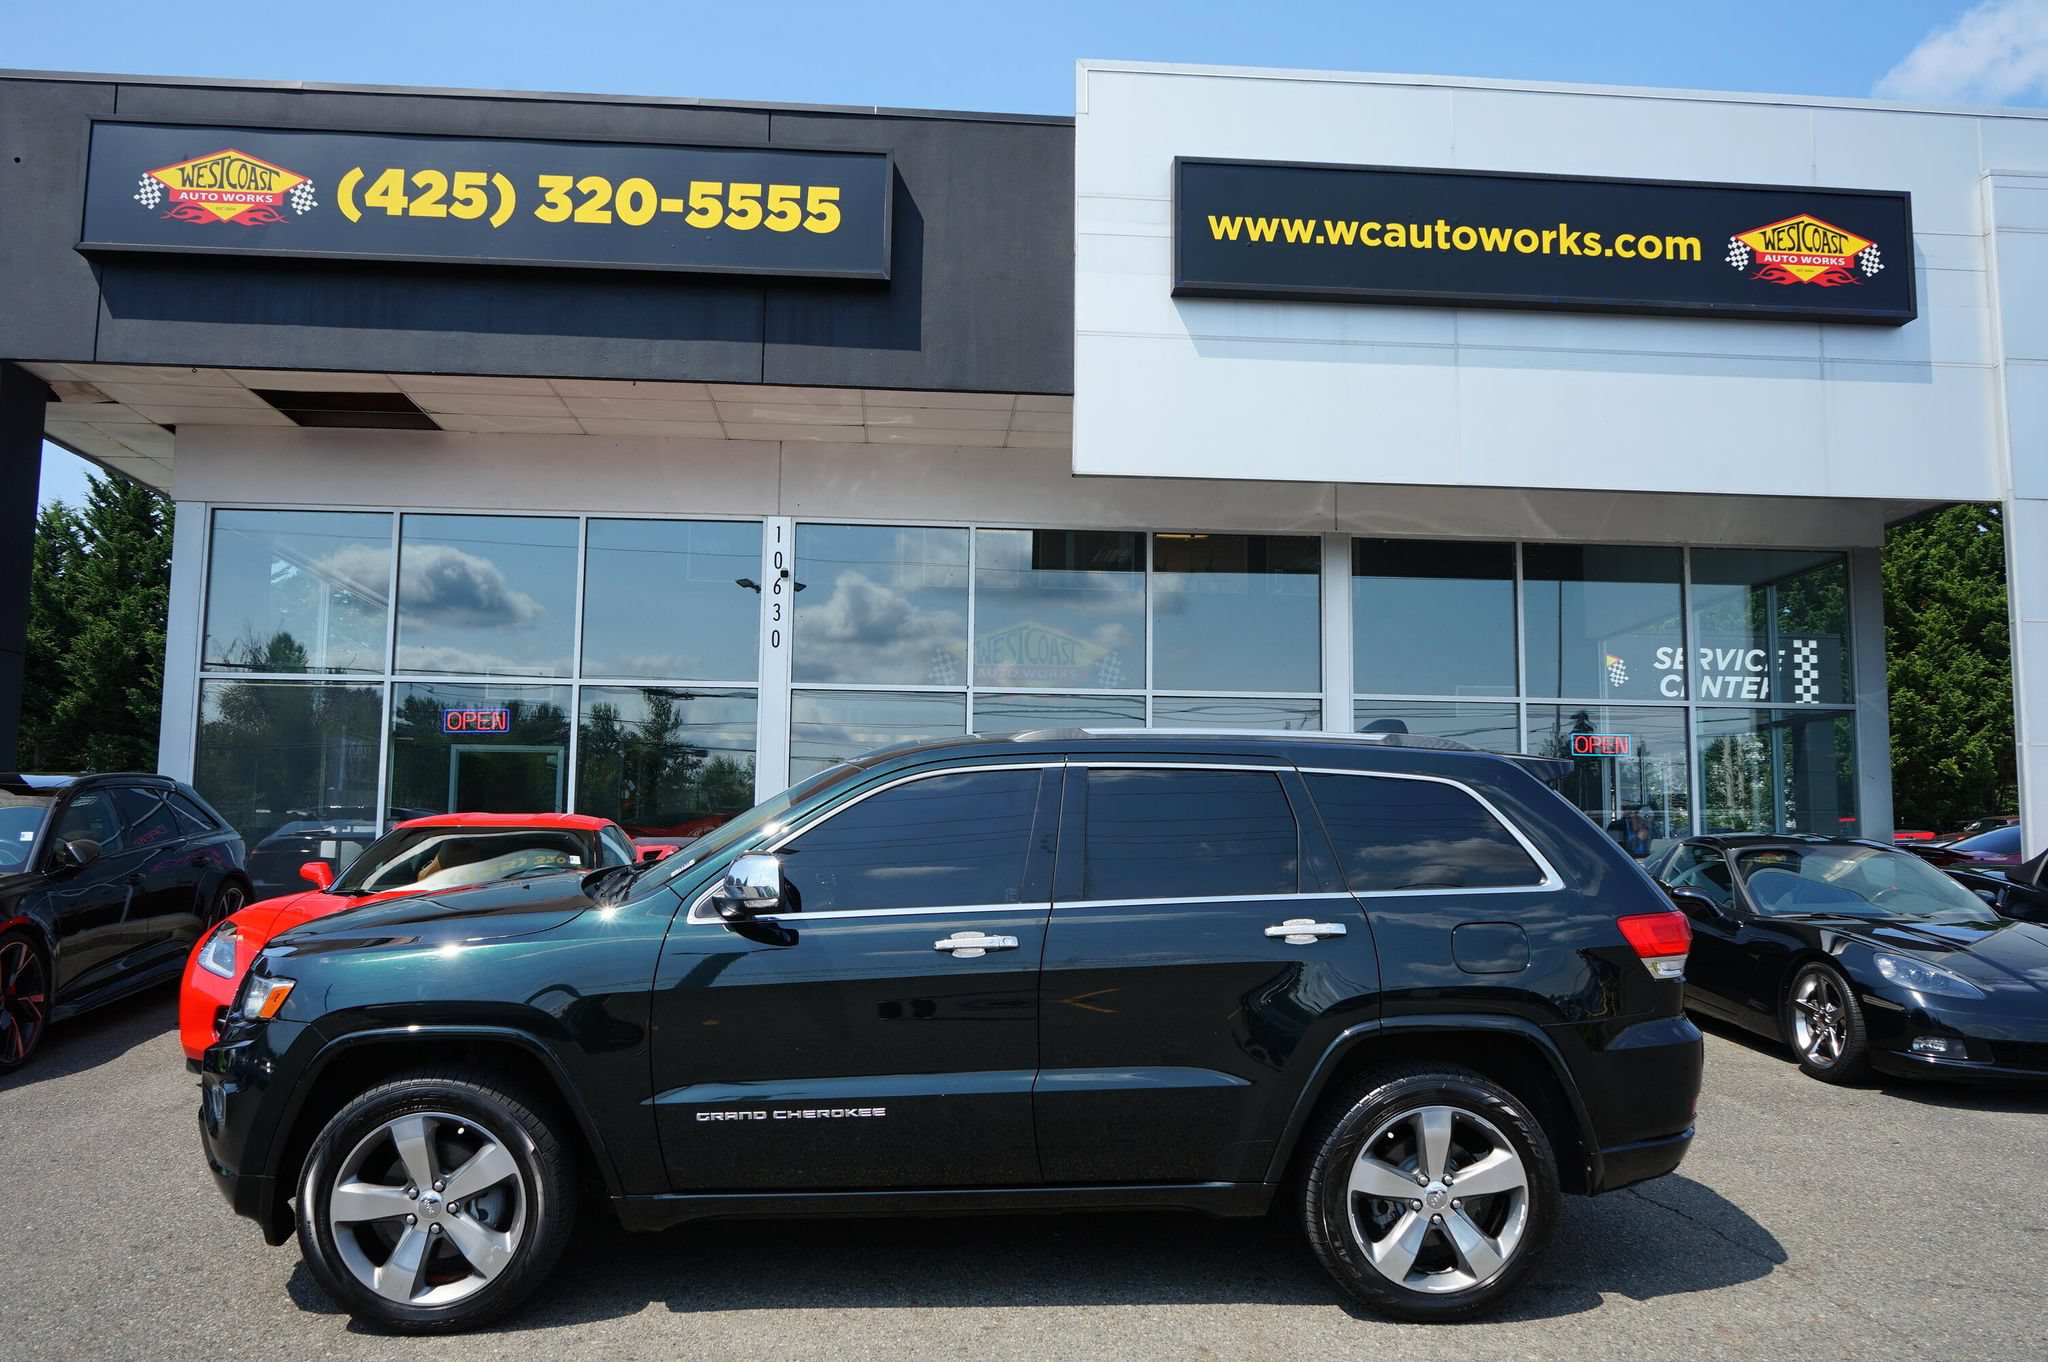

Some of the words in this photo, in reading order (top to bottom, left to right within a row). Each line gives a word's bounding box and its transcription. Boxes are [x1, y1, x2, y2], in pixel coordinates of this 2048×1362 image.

[179, 191, 218, 201] AUTO
[222, 193, 273, 203] WORKS
[337, 167, 516, 228] (425)
[534, 174, 842, 234] 320-5555
[1207, 215, 1702, 261] www.wcautoworks.com
[1763, 254, 1798, 263] AUTO
[1800, 256, 1846, 265] WORKS
[771, 525, 783, 648] 10630
[976, 668, 1018, 678] AUTO
[1023, 668, 1078, 679] WORKS
[447, 711, 506, 730] OPEN
[1575, 736, 1629, 754] OPEN
[696, 1111, 767, 1122] GRAND
[773, 1107, 887, 1120] CHEROKEE
